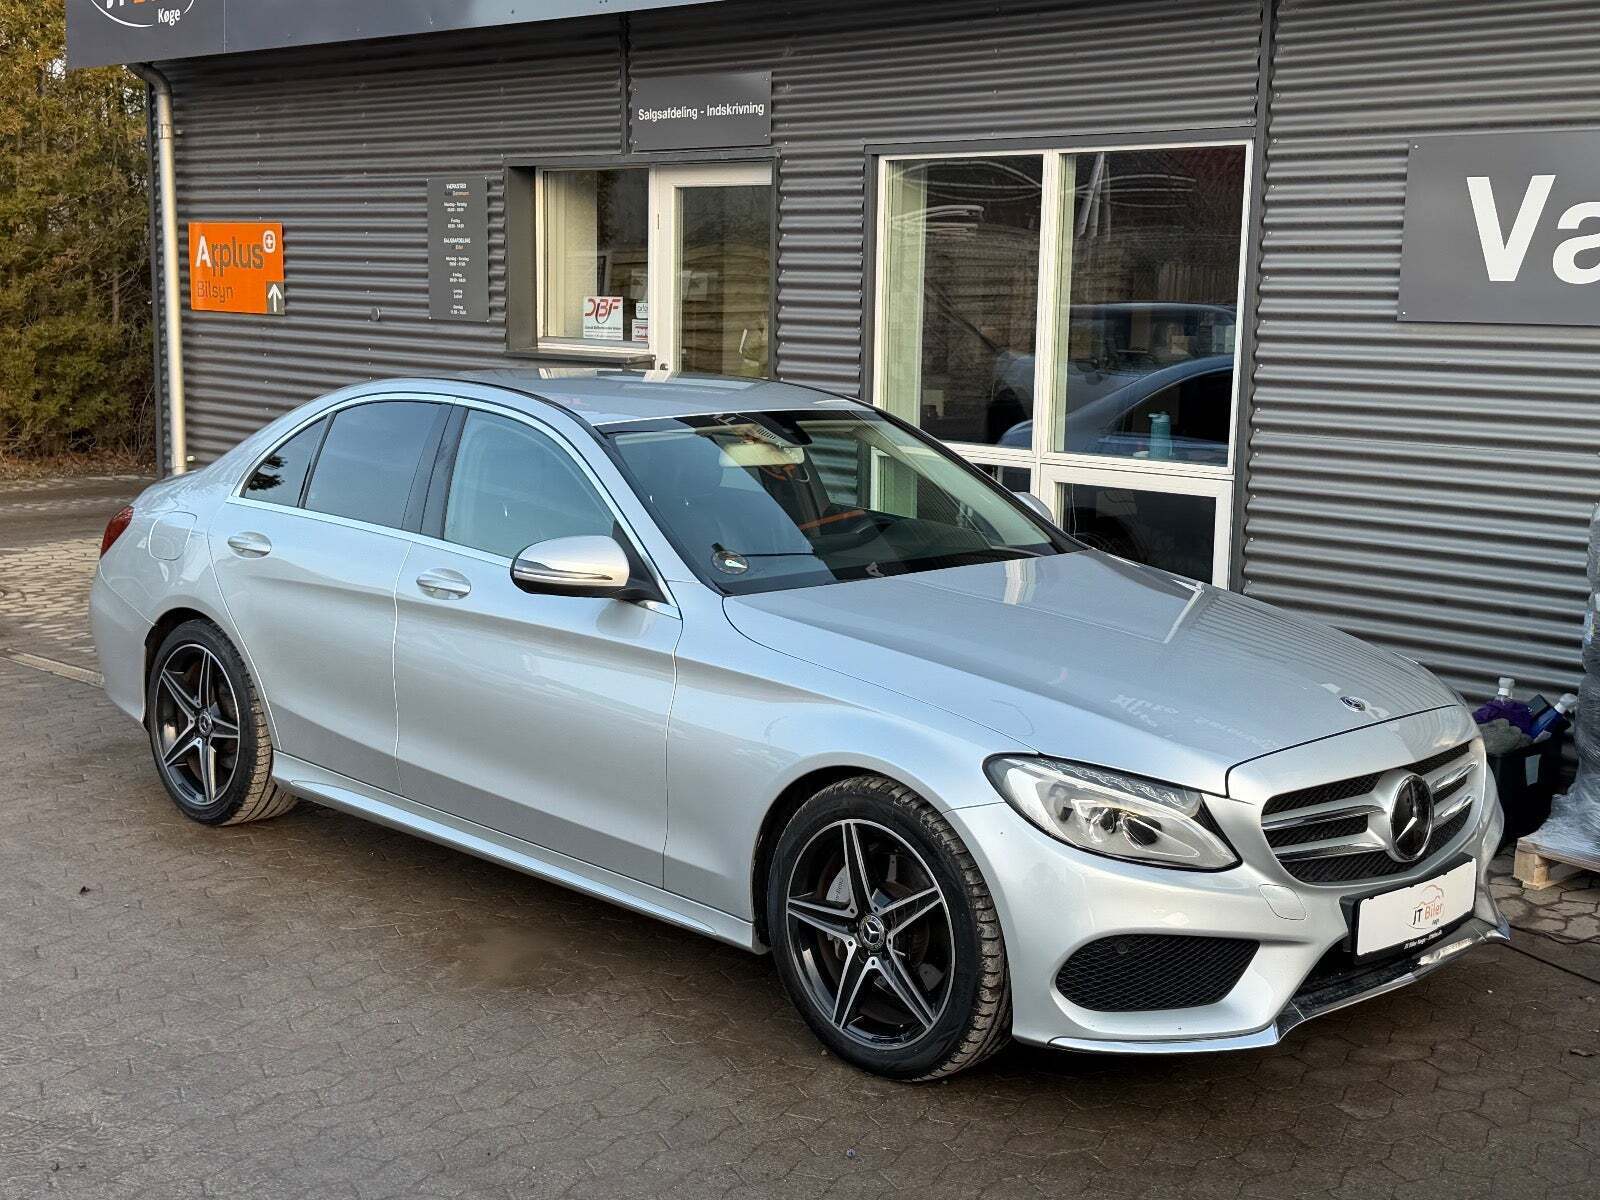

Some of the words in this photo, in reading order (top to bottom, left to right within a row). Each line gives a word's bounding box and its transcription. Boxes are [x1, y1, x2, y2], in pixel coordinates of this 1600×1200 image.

[158, 8, 181, 25] Køge
[638, 106, 698, 122] Salgsafdeling
[706, 101, 765, 116] Indskrivning
[197, 281, 234, 303] Bilsyn
